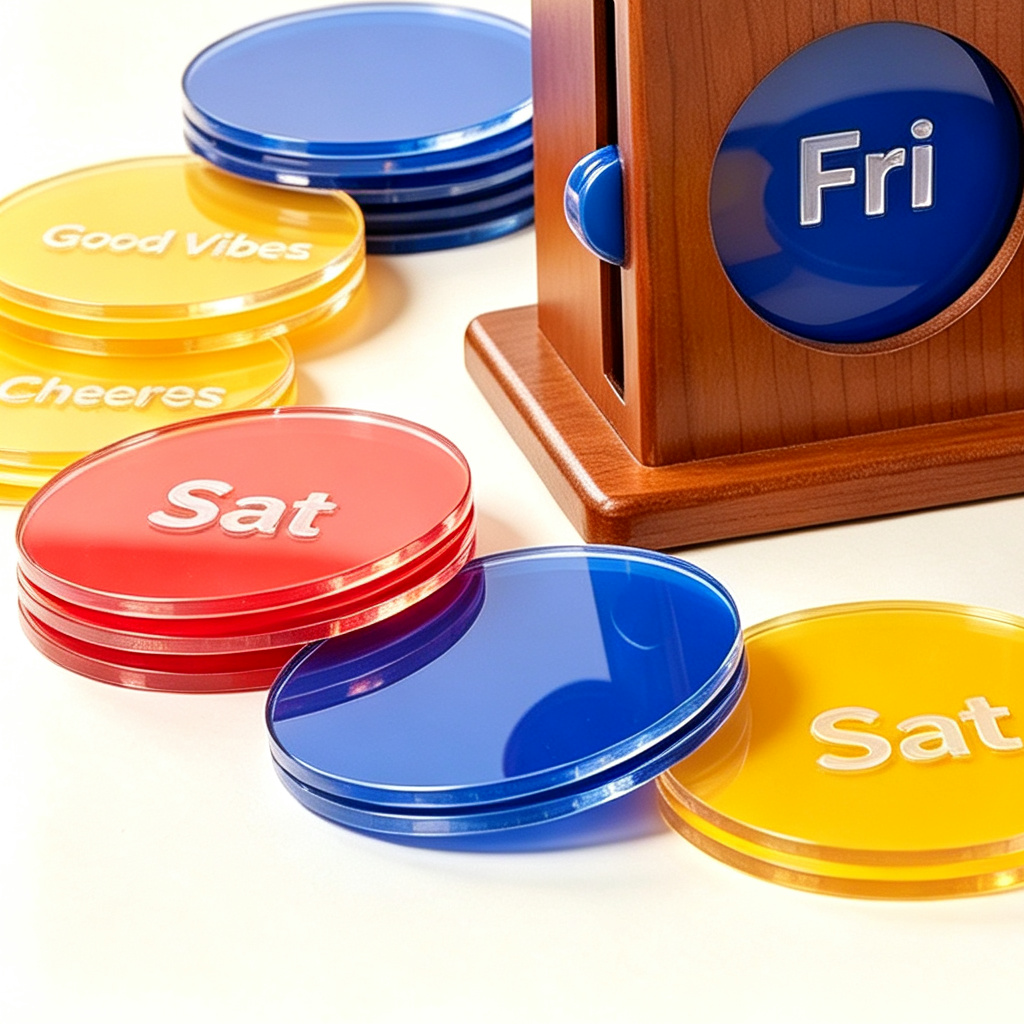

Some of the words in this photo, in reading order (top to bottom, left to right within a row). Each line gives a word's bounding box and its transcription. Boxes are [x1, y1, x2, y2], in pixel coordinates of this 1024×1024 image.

[800, 119, 934, 226] Fri
[42, 223, 175, 256] Good
[186, 231, 312, 262] Vibes
[0, 375, 228, 409] Cheeres
[147, 478, 338, 541] Sat
[810, 696, 1024, 772] Sat
